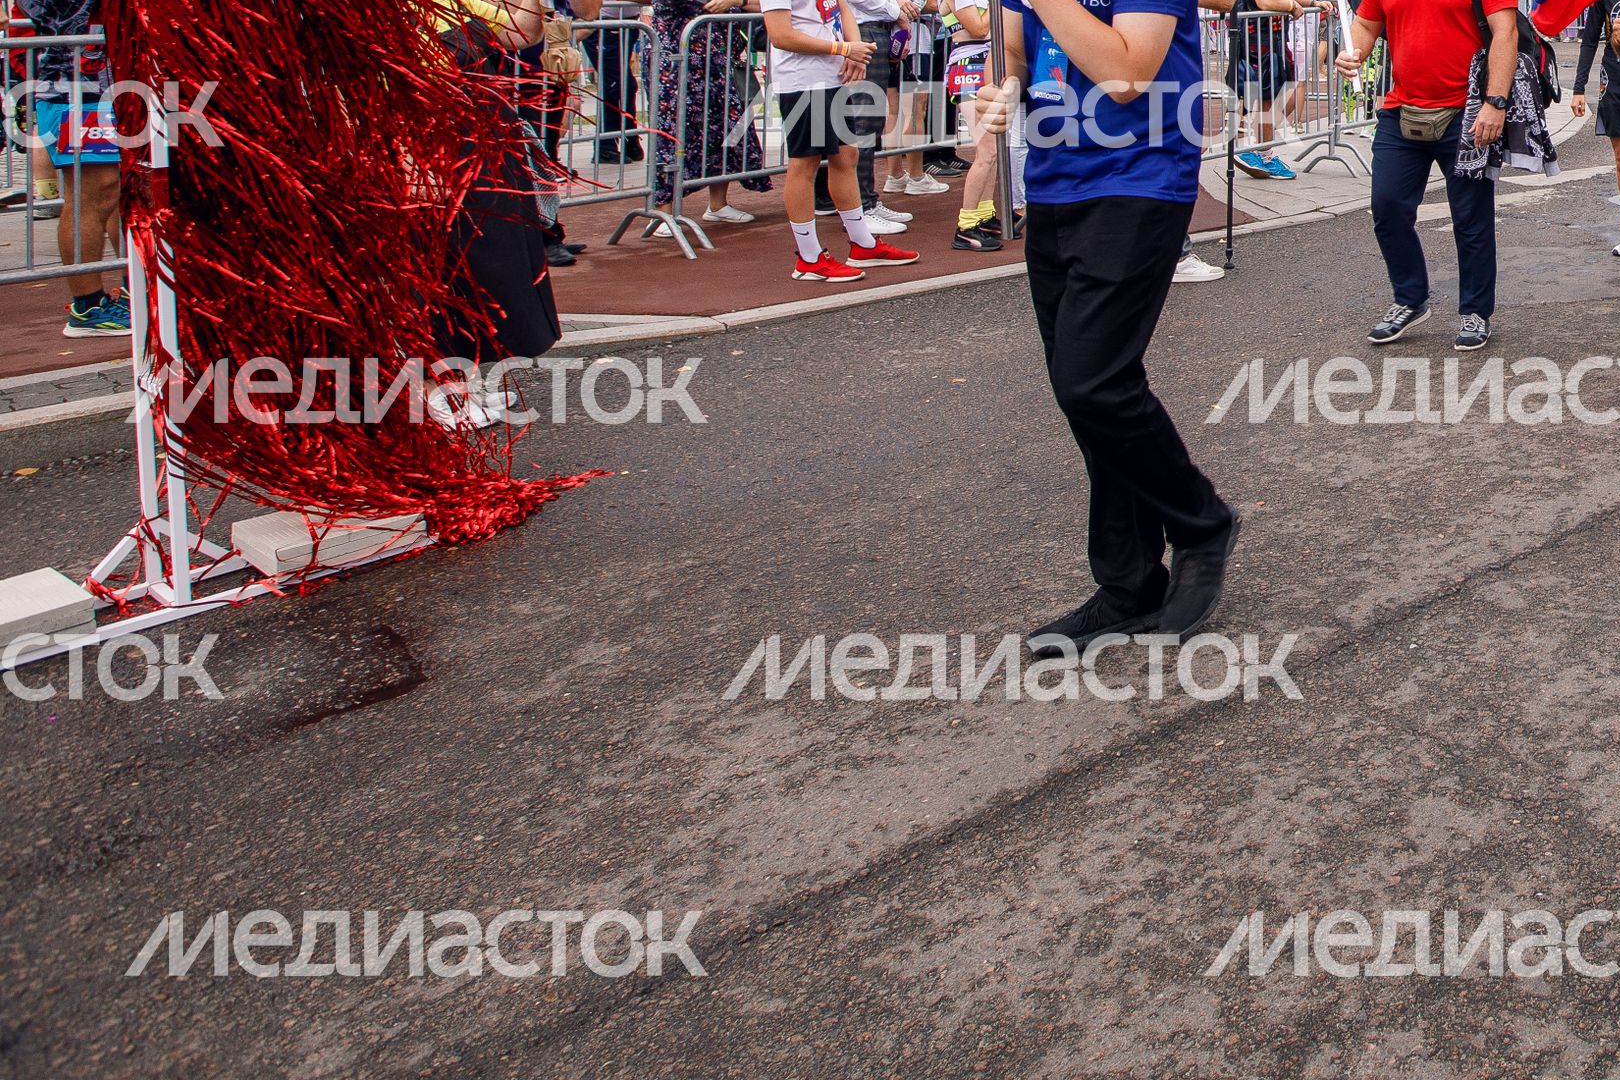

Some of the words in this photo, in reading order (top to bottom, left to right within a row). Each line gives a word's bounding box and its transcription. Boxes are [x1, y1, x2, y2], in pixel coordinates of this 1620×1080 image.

[951, 23, 964, 33] PIN
[954, 74, 981, 85] 8162
[79, 126, 118, 140] 783
